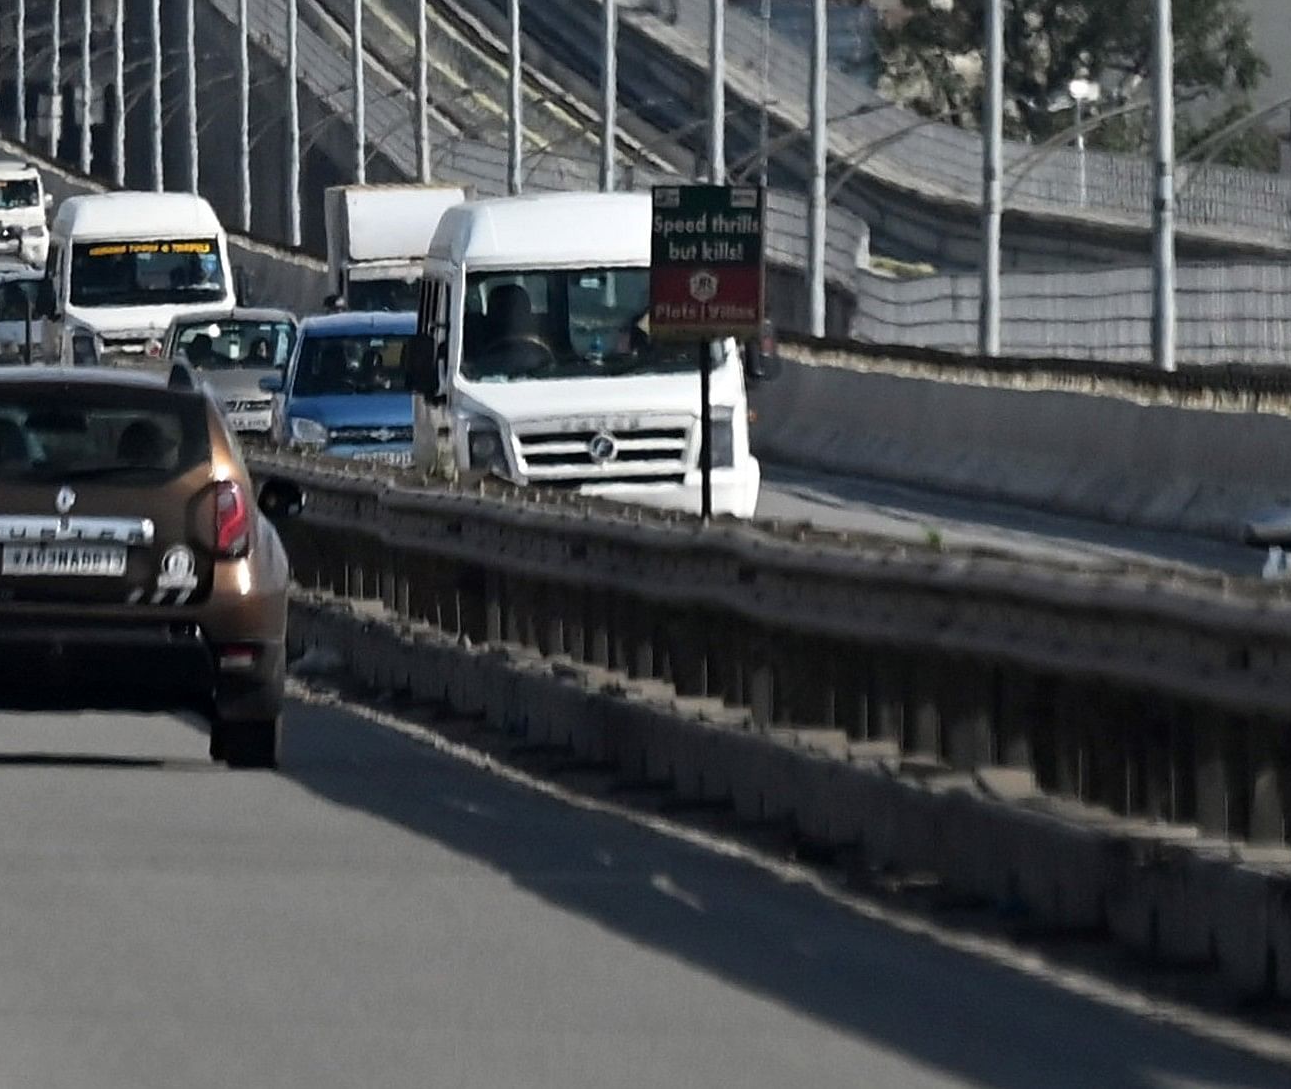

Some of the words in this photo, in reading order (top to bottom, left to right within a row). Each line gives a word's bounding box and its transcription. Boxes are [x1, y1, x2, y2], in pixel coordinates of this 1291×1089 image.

[653, 213, 707, 238] Speed
[712, 213, 759, 234] thrills
[668, 241, 697, 260] but
[702, 241, 744, 260] kills!
